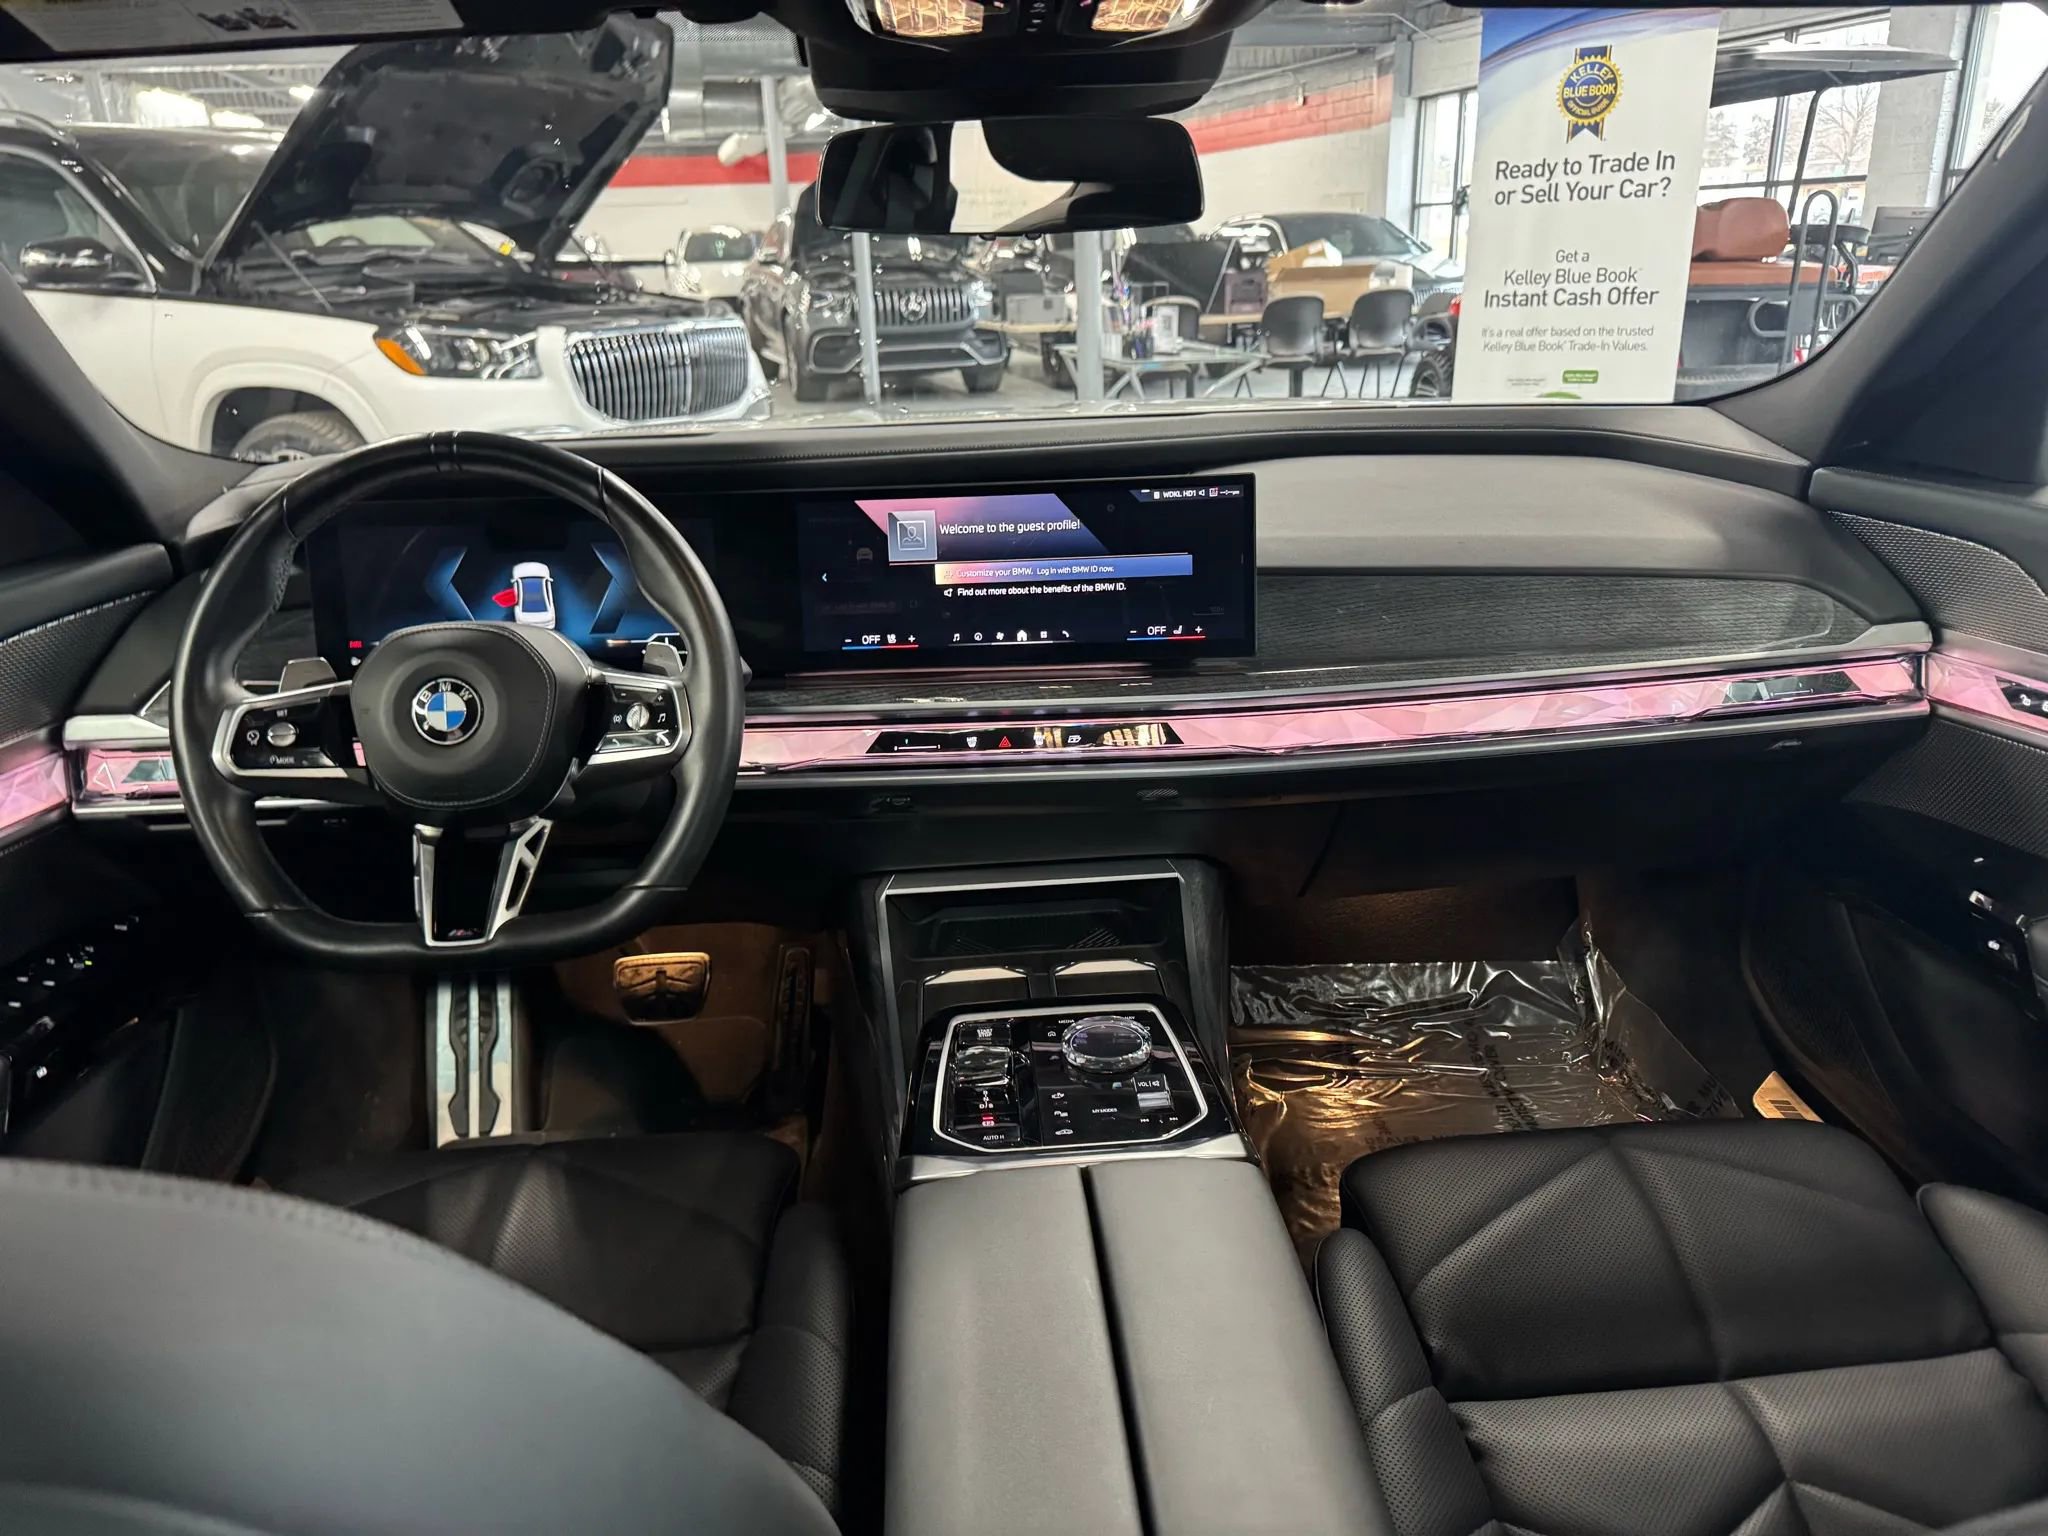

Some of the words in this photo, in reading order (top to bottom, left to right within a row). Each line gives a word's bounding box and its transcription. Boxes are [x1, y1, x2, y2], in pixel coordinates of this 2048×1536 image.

[1570, 64, 1614, 83] KELLEY
[1563, 85, 1589, 99] BLUE
[1589, 83, 1616, 97] BOOK
[1495, 158, 1558, 182] Ready
[1563, 158, 1582, 176] to
[1589, 152, 1650, 174] Trade
[1656, 150, 1676, 171] In
[1494, 190, 1517, 205] or
[1520, 182, 1559, 204] Sell
[1566, 181, 1614, 201] Your
[1619, 176, 1671, 198] Car?
[1555, 249, 1578, 263] Get
[1581, 251, 1590, 263] a
[1504, 269, 1551, 288] Kelley
[1555, 268, 1591, 285] Blue
[1484, 289, 1548, 308] Instant
[1553, 287, 1601, 306] Cash
[1607, 286, 1660, 305] Offer
[1481, 326, 1494, 337] It's
[1496, 329, 1503, 337] a
[1505, 327, 1523, 337] real
[1526, 327, 1548, 337] offer
[1550, 326, 1581, 337] based
[1583, 328, 1596, 336] on
[1598, 326, 1614, 336] the
[1617, 325, 1654, 336] trusted
[1483, 342, 1513, 354] Kelley
[1514, 341, 1536, 351] Blue
[1568, 340, 1610, 351] Trade-In
[940, 524, 984, 534] Welcome
[987, 523, 996, 533] to
[999, 522, 1014, 532] the
[1017, 521, 1045, 534] guest
[1047, 519, 1081, 532] profile!
[995, 569, 1011, 578] your
[1012, 567, 1033, 576] BMW.
[1037, 567, 1049, 576] Log
[1091, 565, 1098, 573] ID
[957, 588, 974, 597] Find
[975, 588, 987, 596] out
[988, 588, 1007, 596] more
[1008, 586, 1029, 595] about
[1030, 585, 1042, 594] the
[1043, 585, 1072, 593] benefits
[1073, 584, 1081, 592] of
[1082, 584, 1094, 592] the
[1095, 583, 1115, 591] BMW
[1116, 582, 1126, 590] ID.
[1147, 626, 1166, 635] OFF
[862, 635, 880, 645] OFF
[420, 681, 473, 702] BMW
